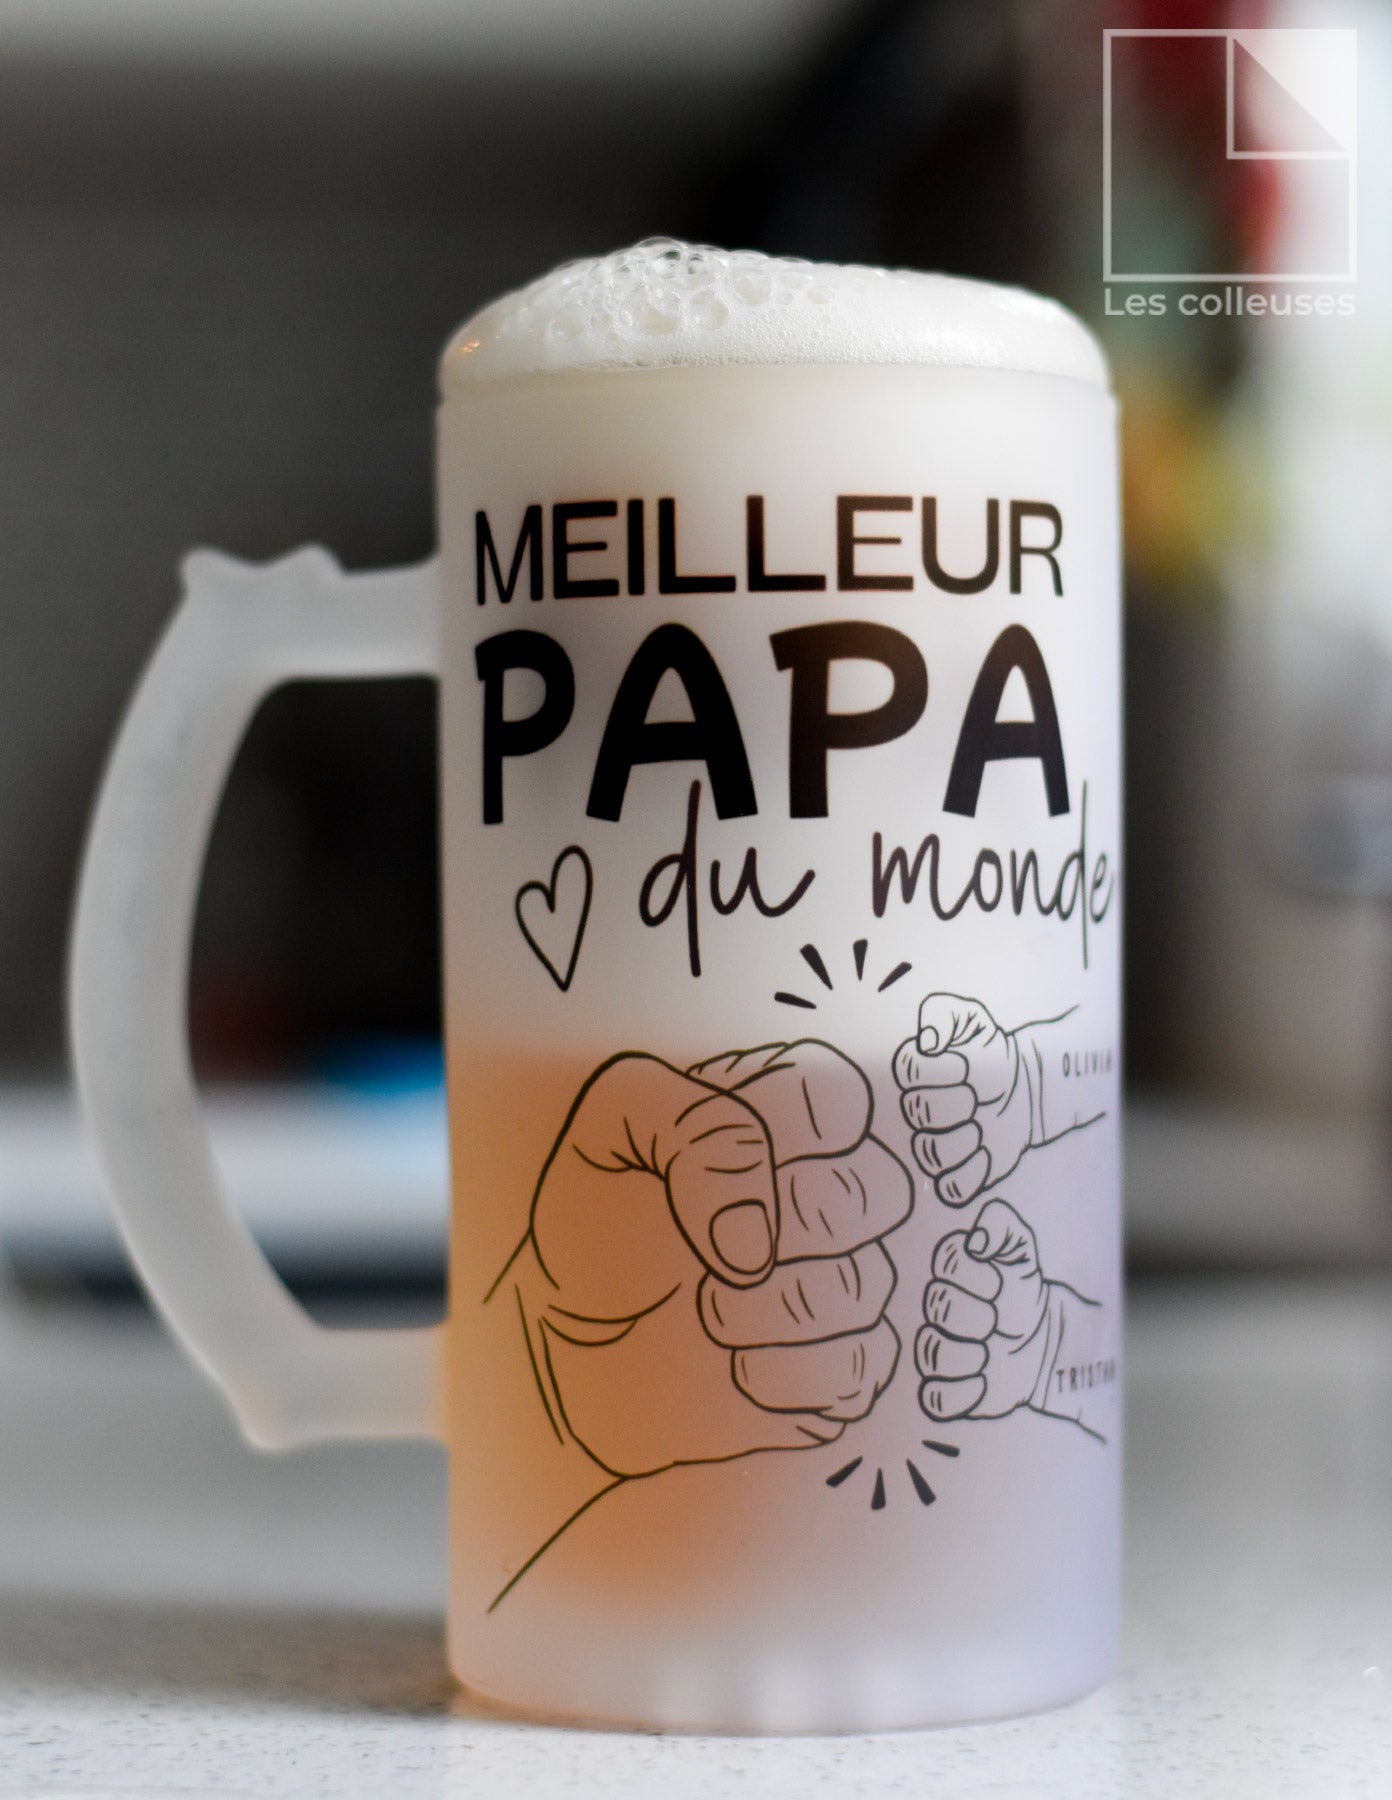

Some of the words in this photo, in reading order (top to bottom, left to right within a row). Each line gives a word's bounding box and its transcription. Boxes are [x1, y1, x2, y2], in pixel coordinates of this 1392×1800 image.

[475, 495, 1063, 605] MEILLEUR
[474, 620, 1071, 825] PAPA
[638, 779, 816, 977] du
[872, 780, 1115, 970] monde
